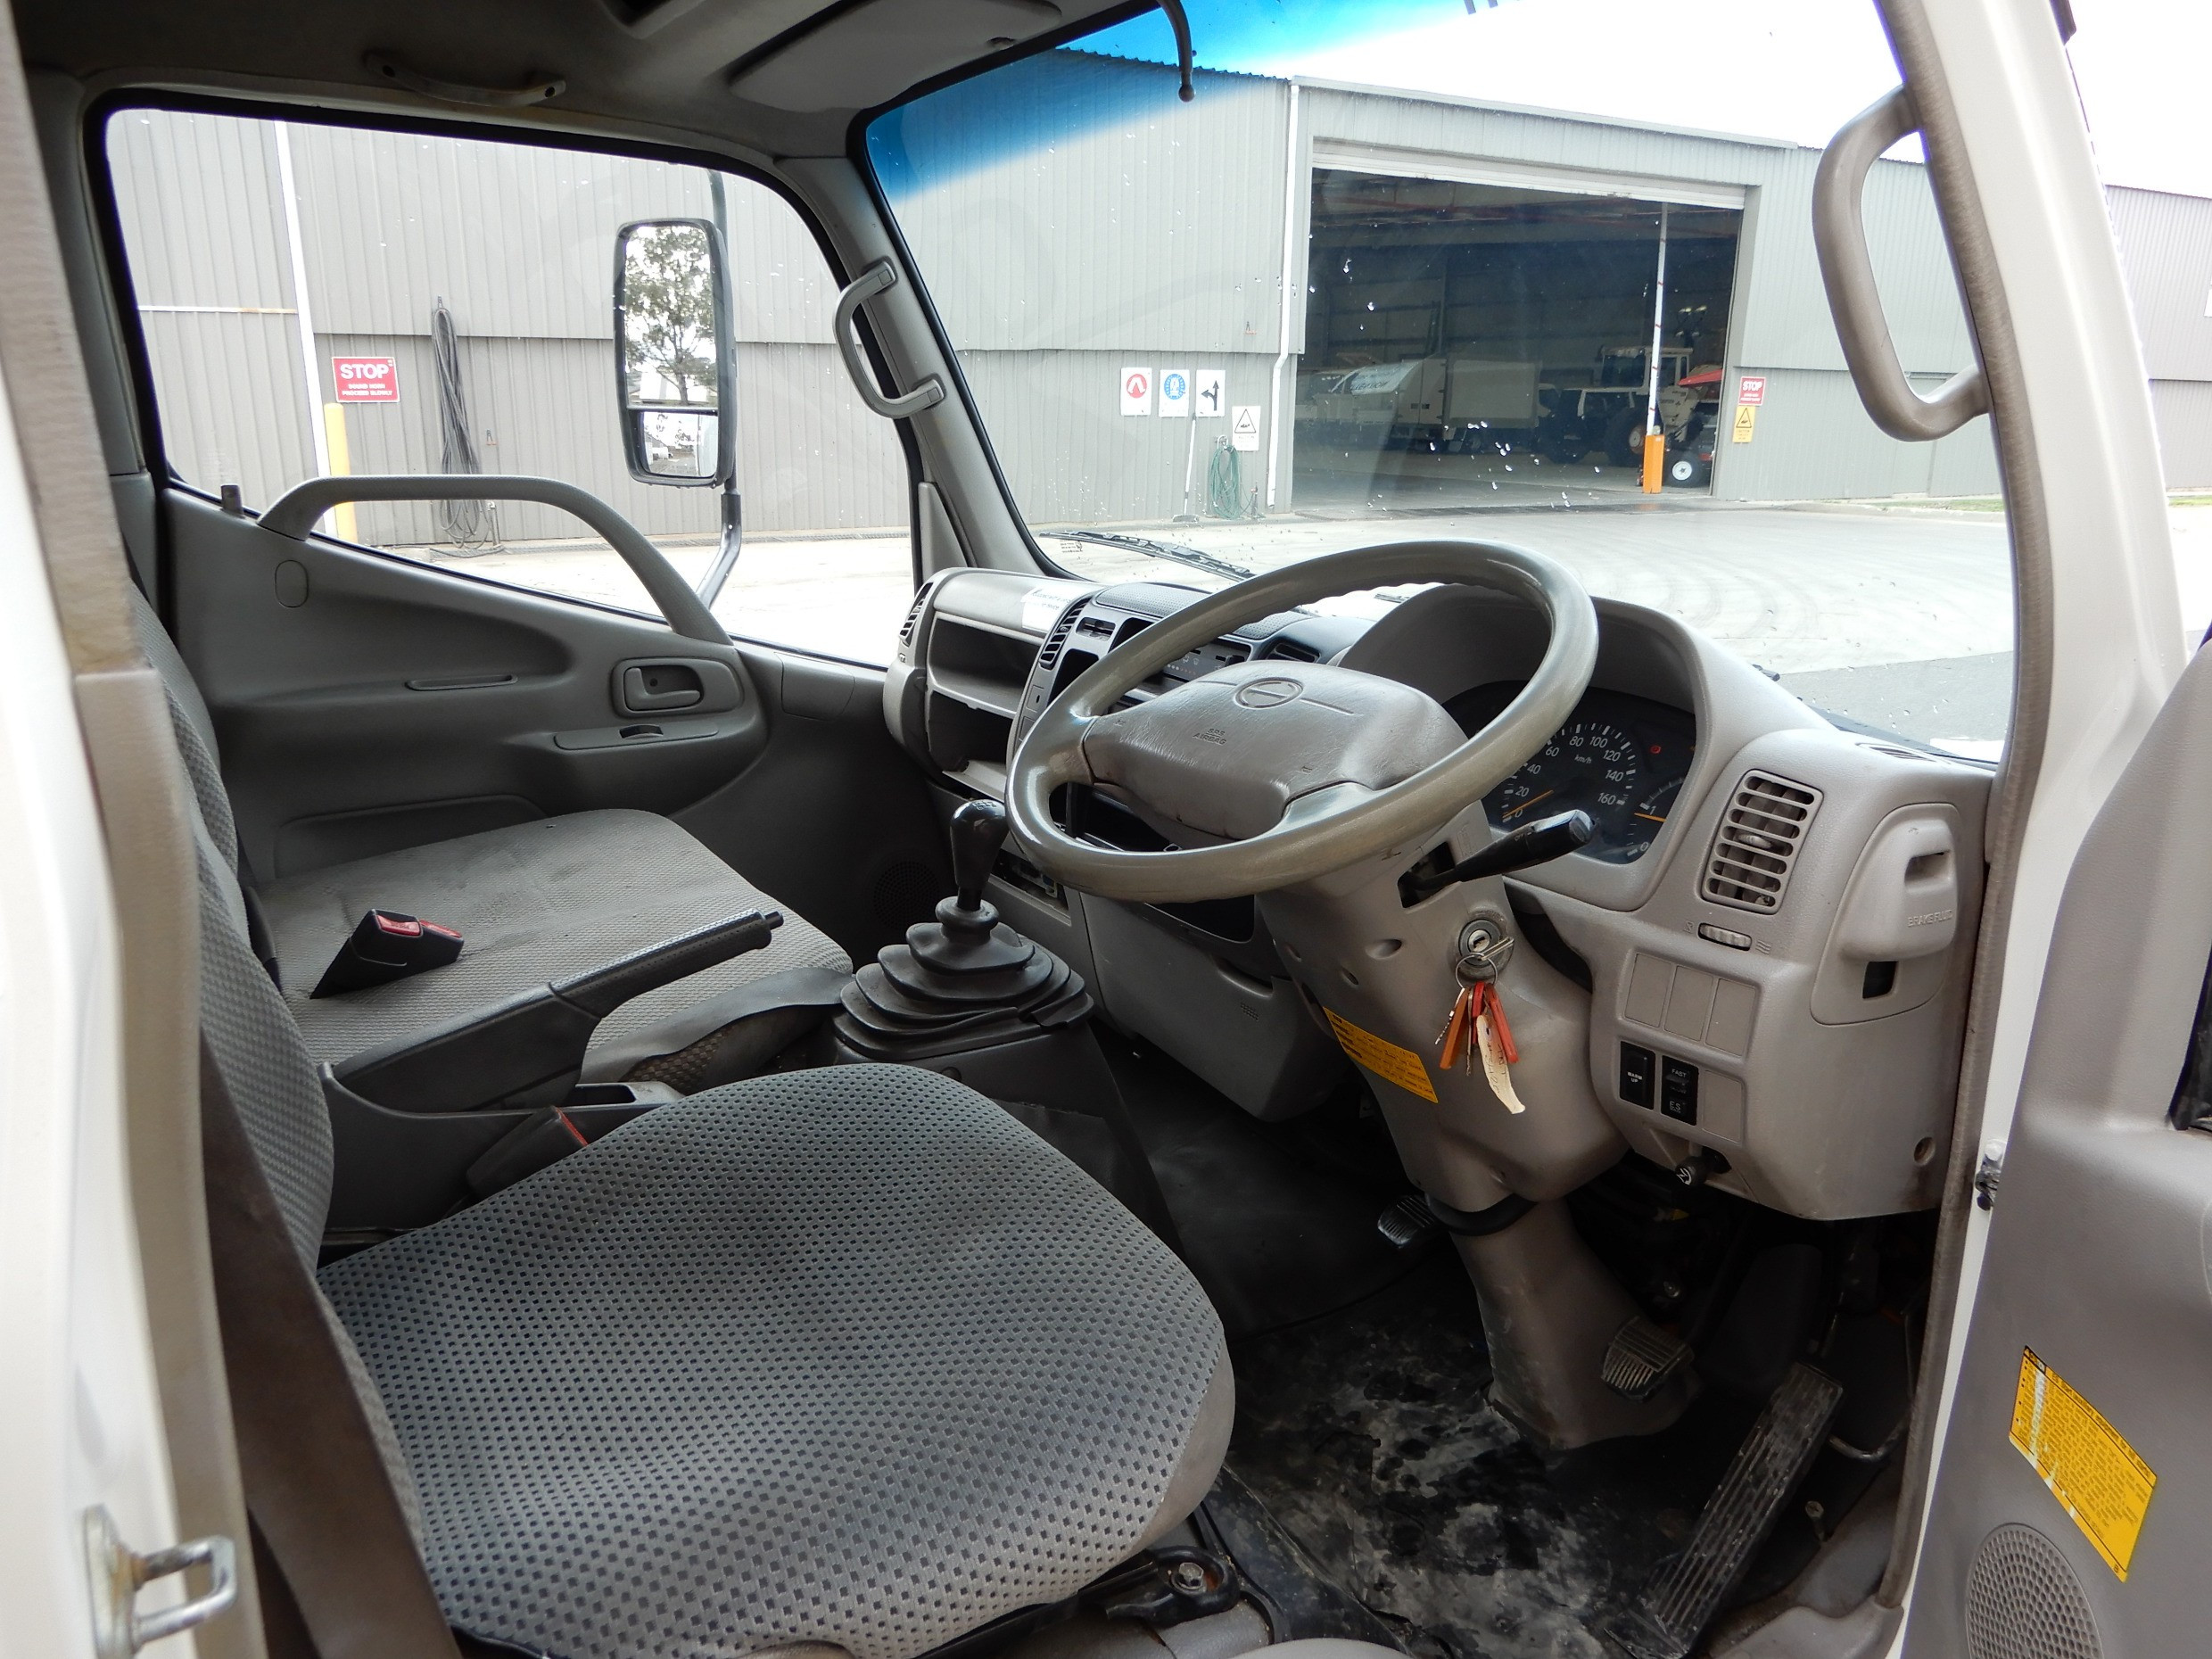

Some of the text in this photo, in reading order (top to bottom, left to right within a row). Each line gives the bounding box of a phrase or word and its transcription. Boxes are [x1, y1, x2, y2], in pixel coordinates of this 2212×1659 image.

[340, 363, 390, 380] STOP
[1742, 380, 1763, 392] STOP
[1193, 731, 1227, 746] AIRBAG
[1569, 736, 1584, 747] 80
[1589, 736, 1608, 748] 100
[1545, 747, 1560, 757] 60
[1603, 749, 1622, 762] 120
[1573, 754, 1592, 764] km/h
[1527, 764, 1541, 775] 40
[1605, 769, 1624, 782] 140
[1515, 786, 1530, 797] 20
[1597, 792, 1616, 805] 160
[1639, 841, 1649, 852] 0
[1627, 1071, 1643, 1080] WARM
[1671, 1069, 1688, 1078] FAST
